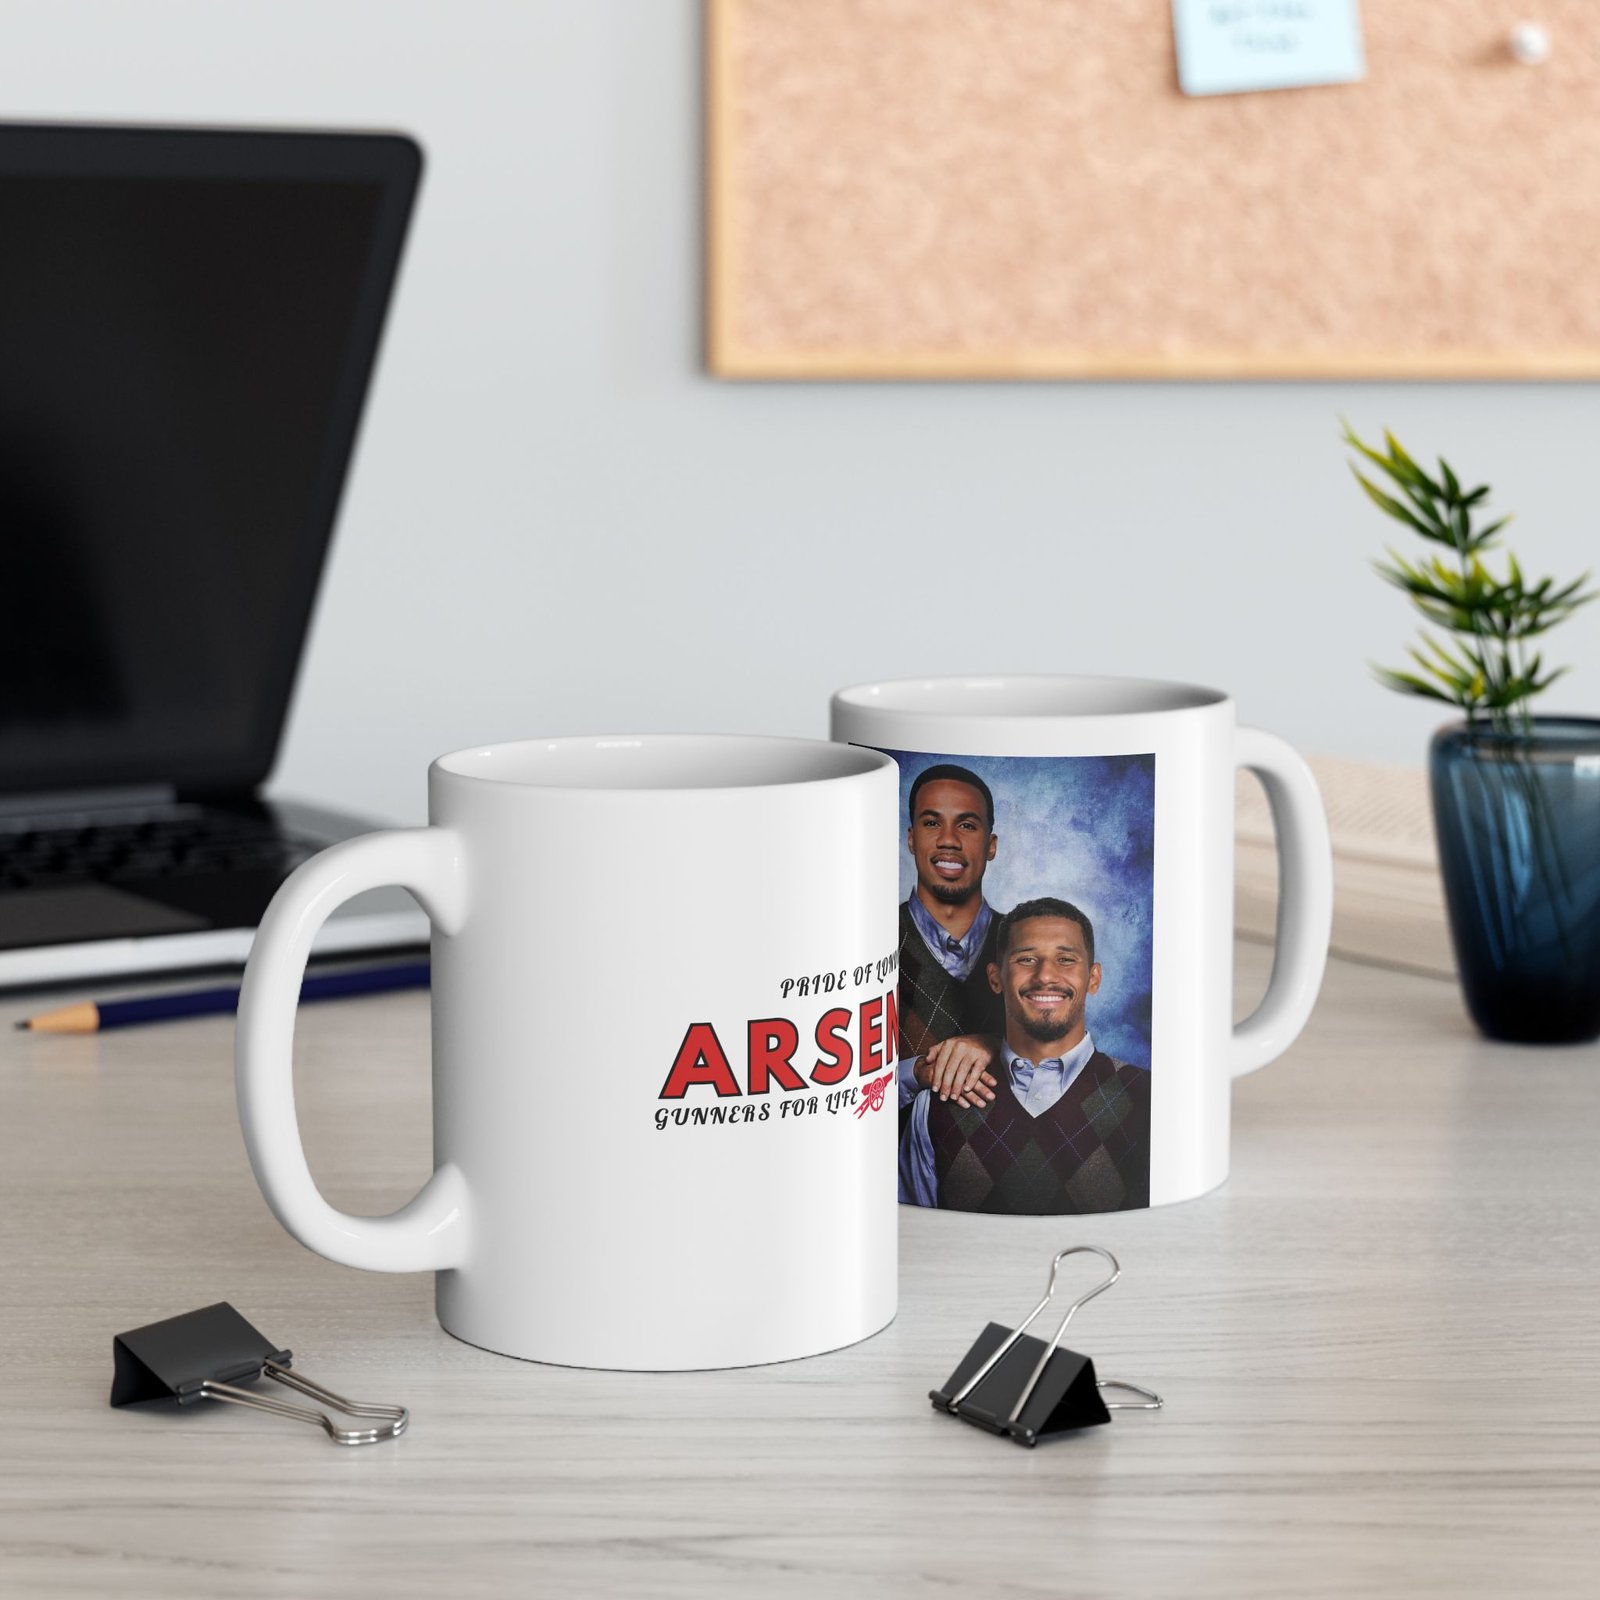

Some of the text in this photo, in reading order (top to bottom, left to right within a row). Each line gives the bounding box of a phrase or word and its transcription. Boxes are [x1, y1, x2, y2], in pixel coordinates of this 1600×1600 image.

[780, 970, 847, 998] PRIDE
[853, 963, 873, 986] OF
[654, 1087, 859, 1131] GUNNERS FOR LIFE
